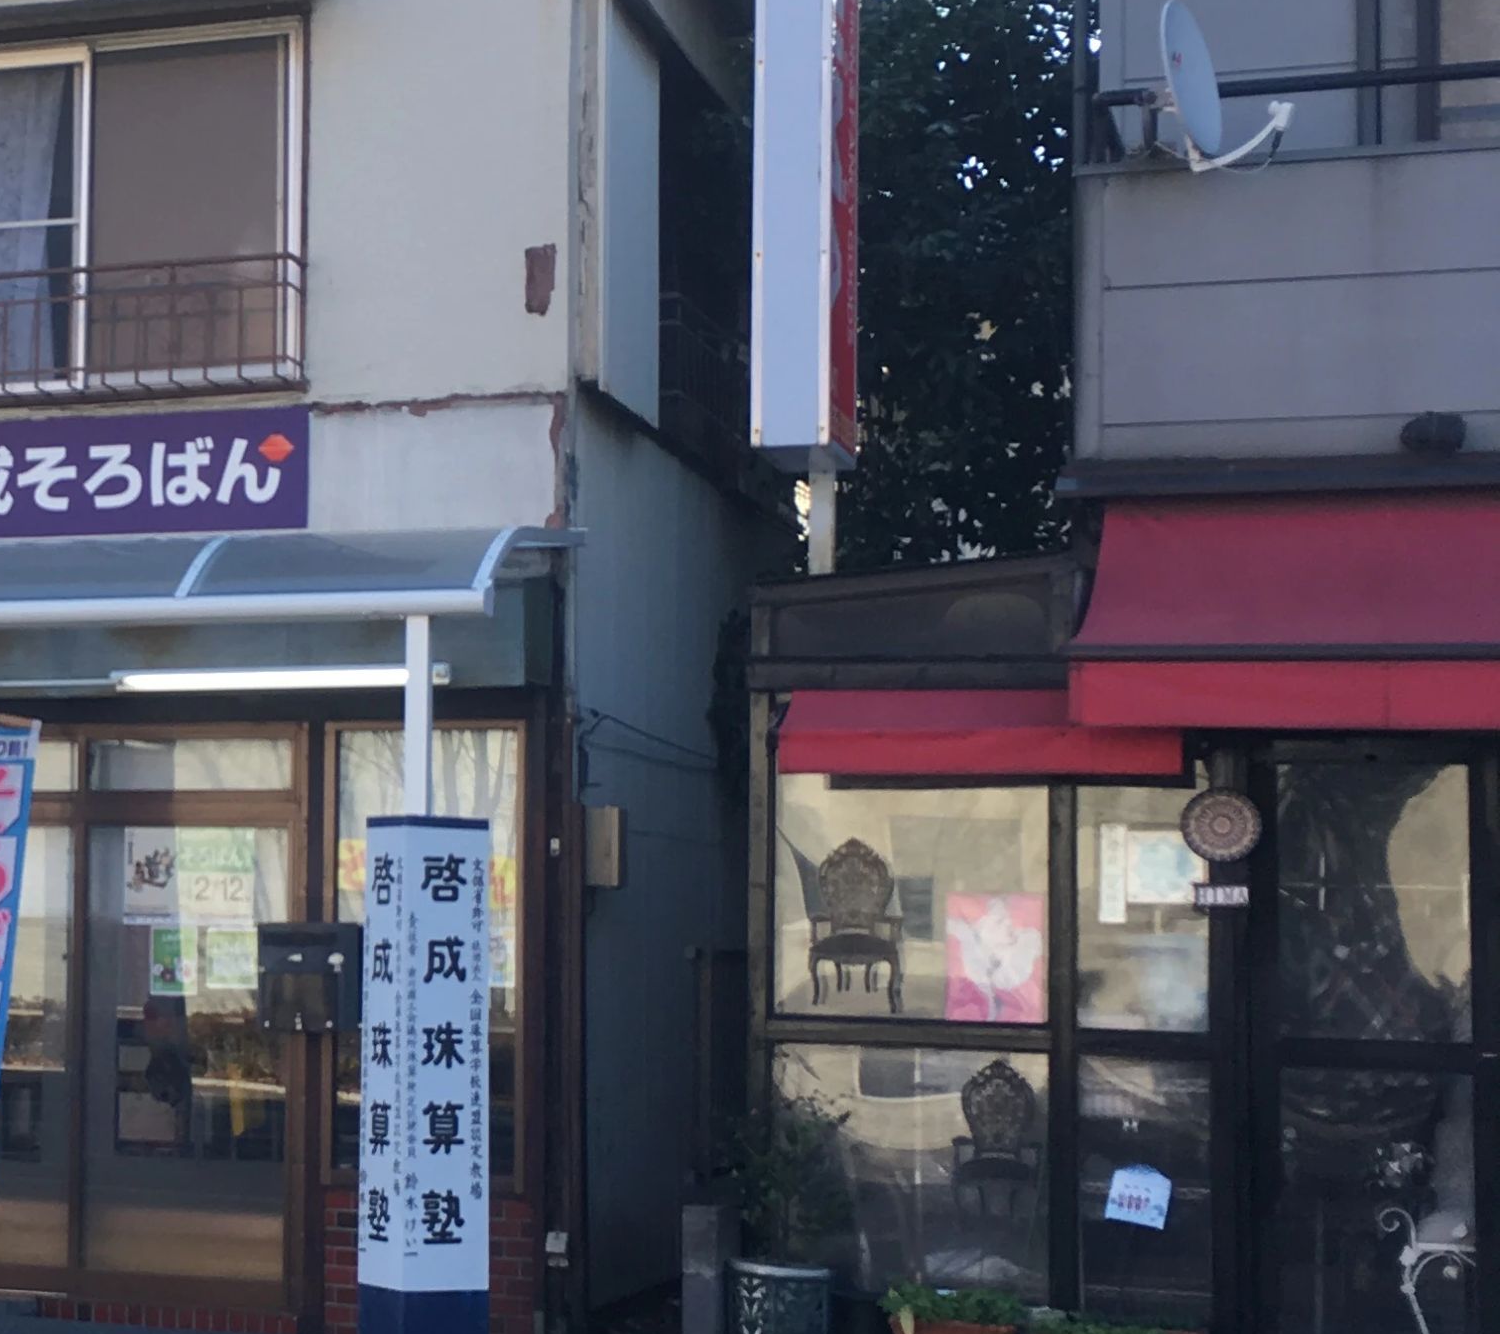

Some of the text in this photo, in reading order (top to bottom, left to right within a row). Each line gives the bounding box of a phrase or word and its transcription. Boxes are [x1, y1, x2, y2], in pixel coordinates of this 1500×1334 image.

[368, 852, 395, 1243] 啓成珠算塾
[421, 853, 467, 1245] 啓成珠算塾
